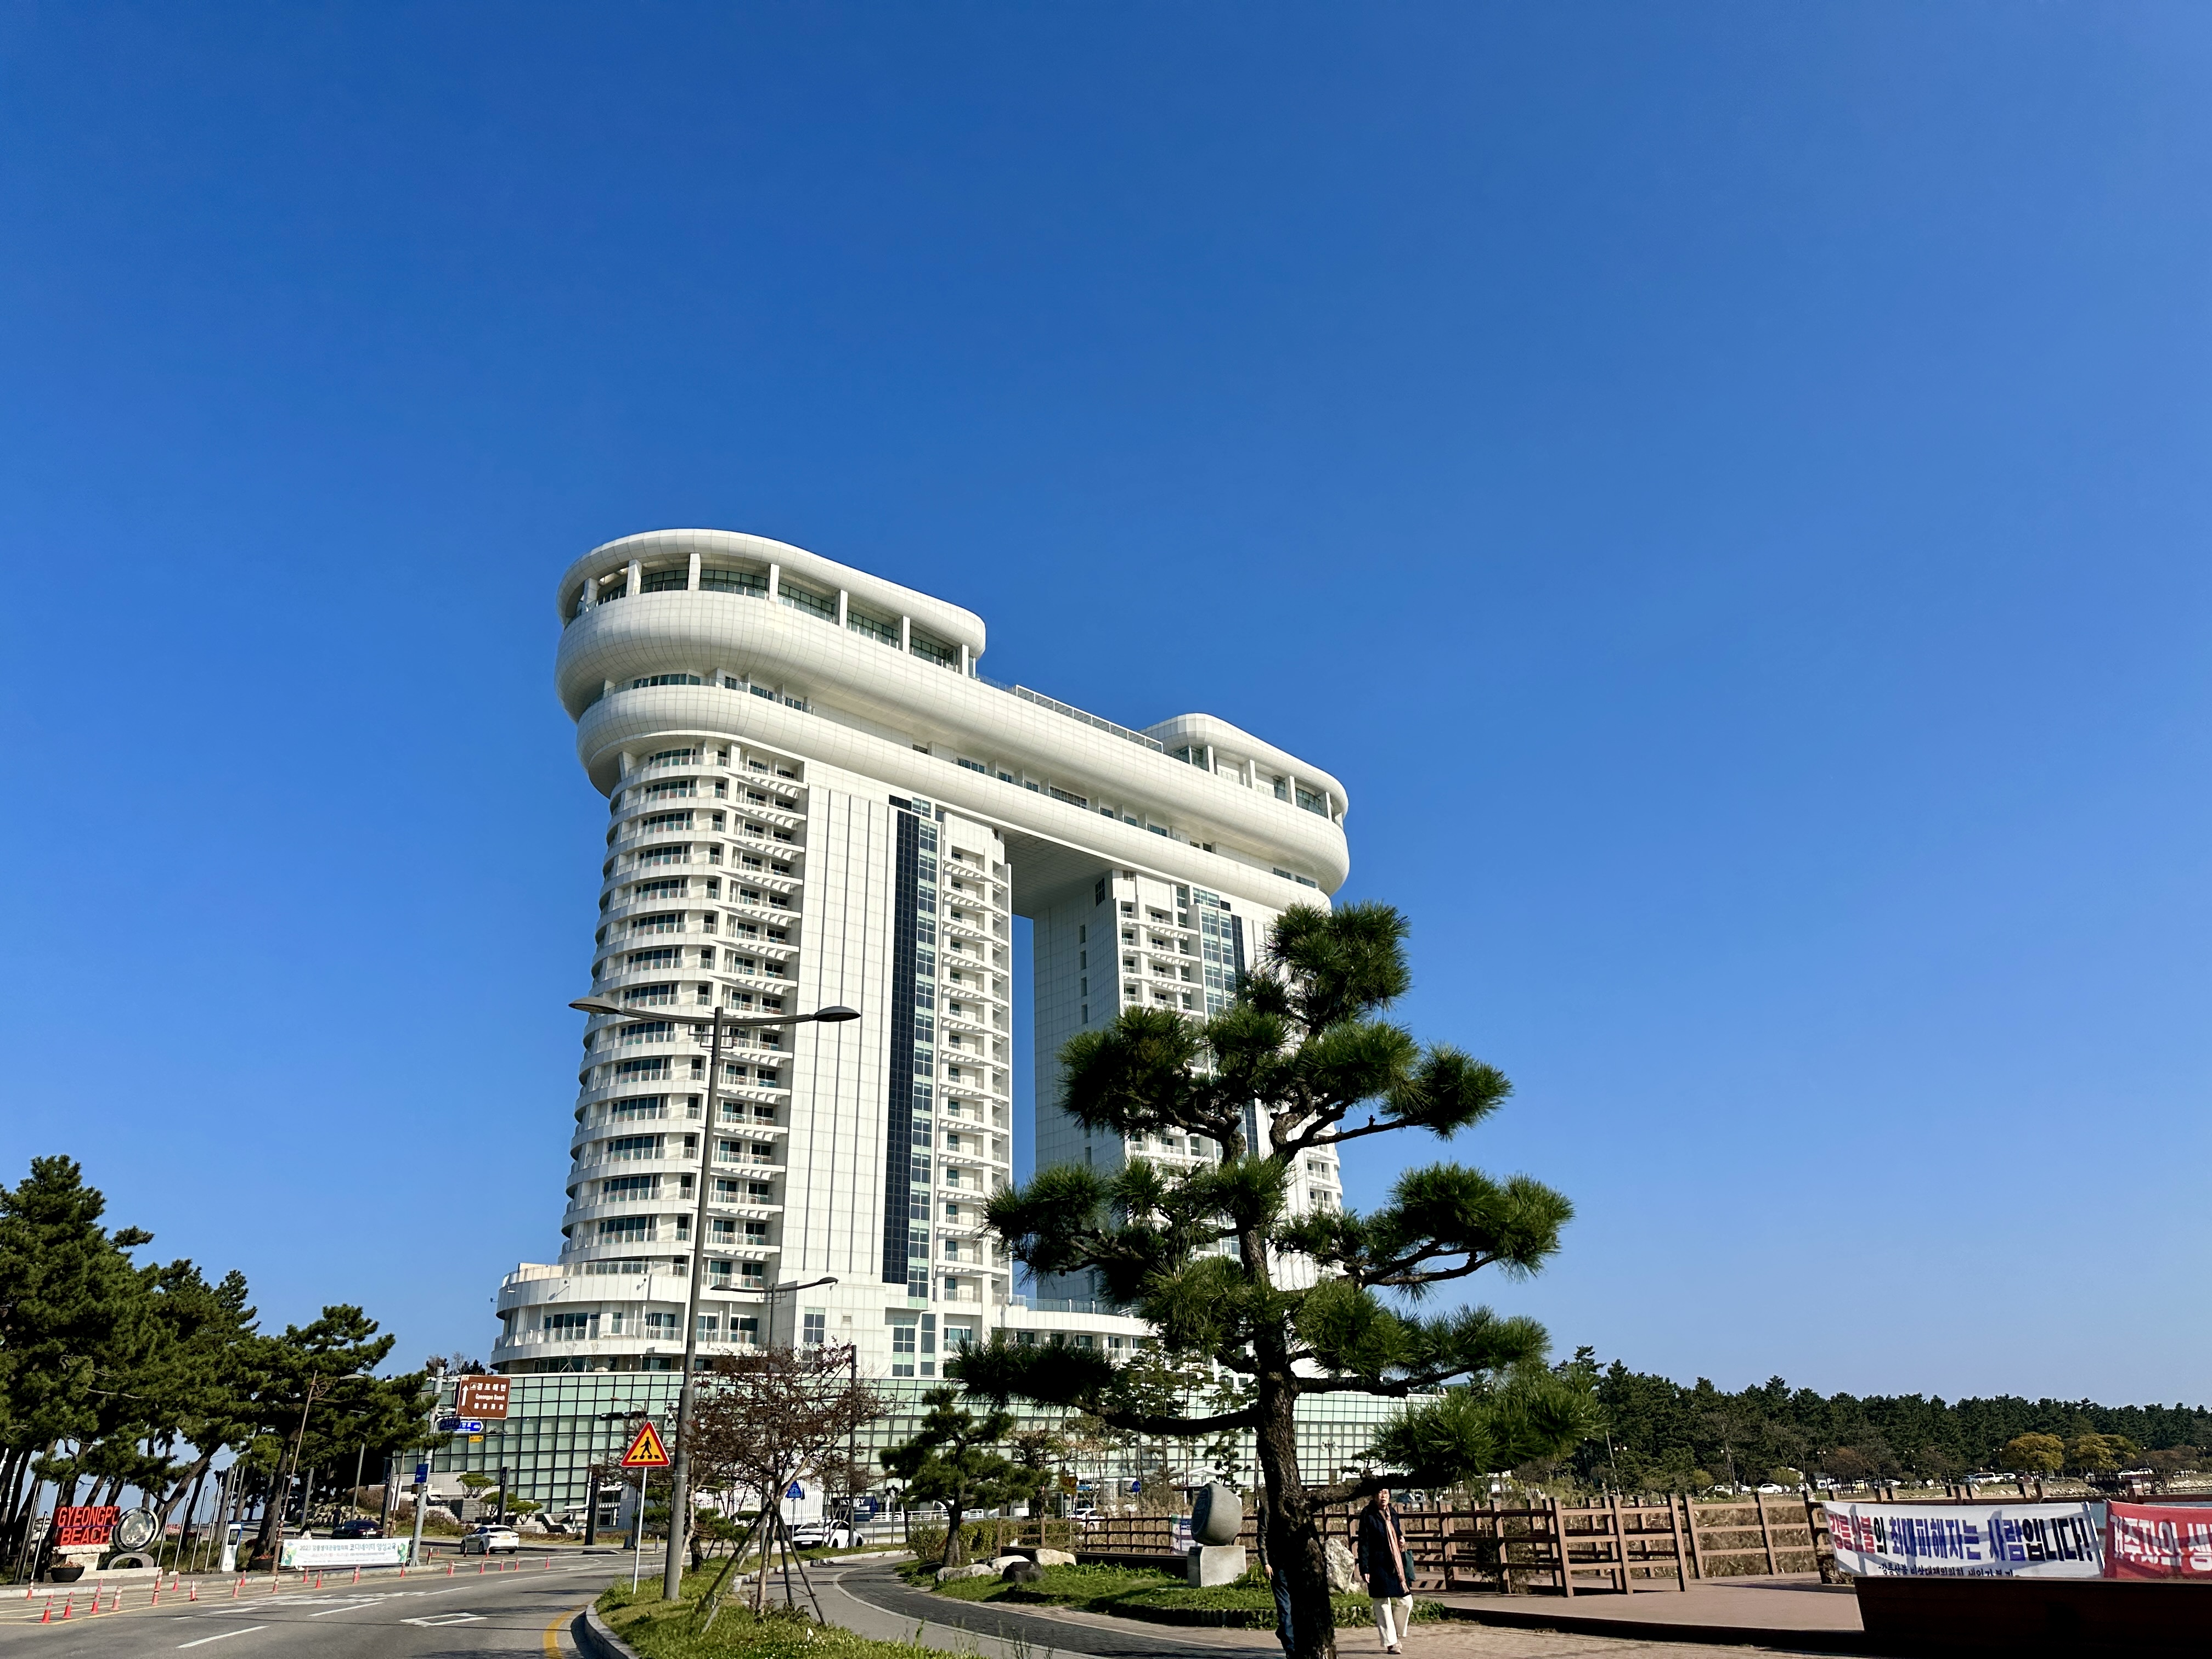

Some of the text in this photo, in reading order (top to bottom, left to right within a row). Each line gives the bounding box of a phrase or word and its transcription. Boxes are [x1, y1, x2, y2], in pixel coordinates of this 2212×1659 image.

[477, 1383, 506, 1392] 경포해변
[58, 1506, 120, 1527] GYEONGPO
[60, 1527, 111, 1545] BEACH
[1829, 1514, 2093, 1562] 강릉산불의 최대피해자는 사람입니다!
[349, 1543, 375, 1551] 코디네이터
[376, 1542, 396, 1551] 양성교육
[2187, 1523, 2212, 1571] 생
